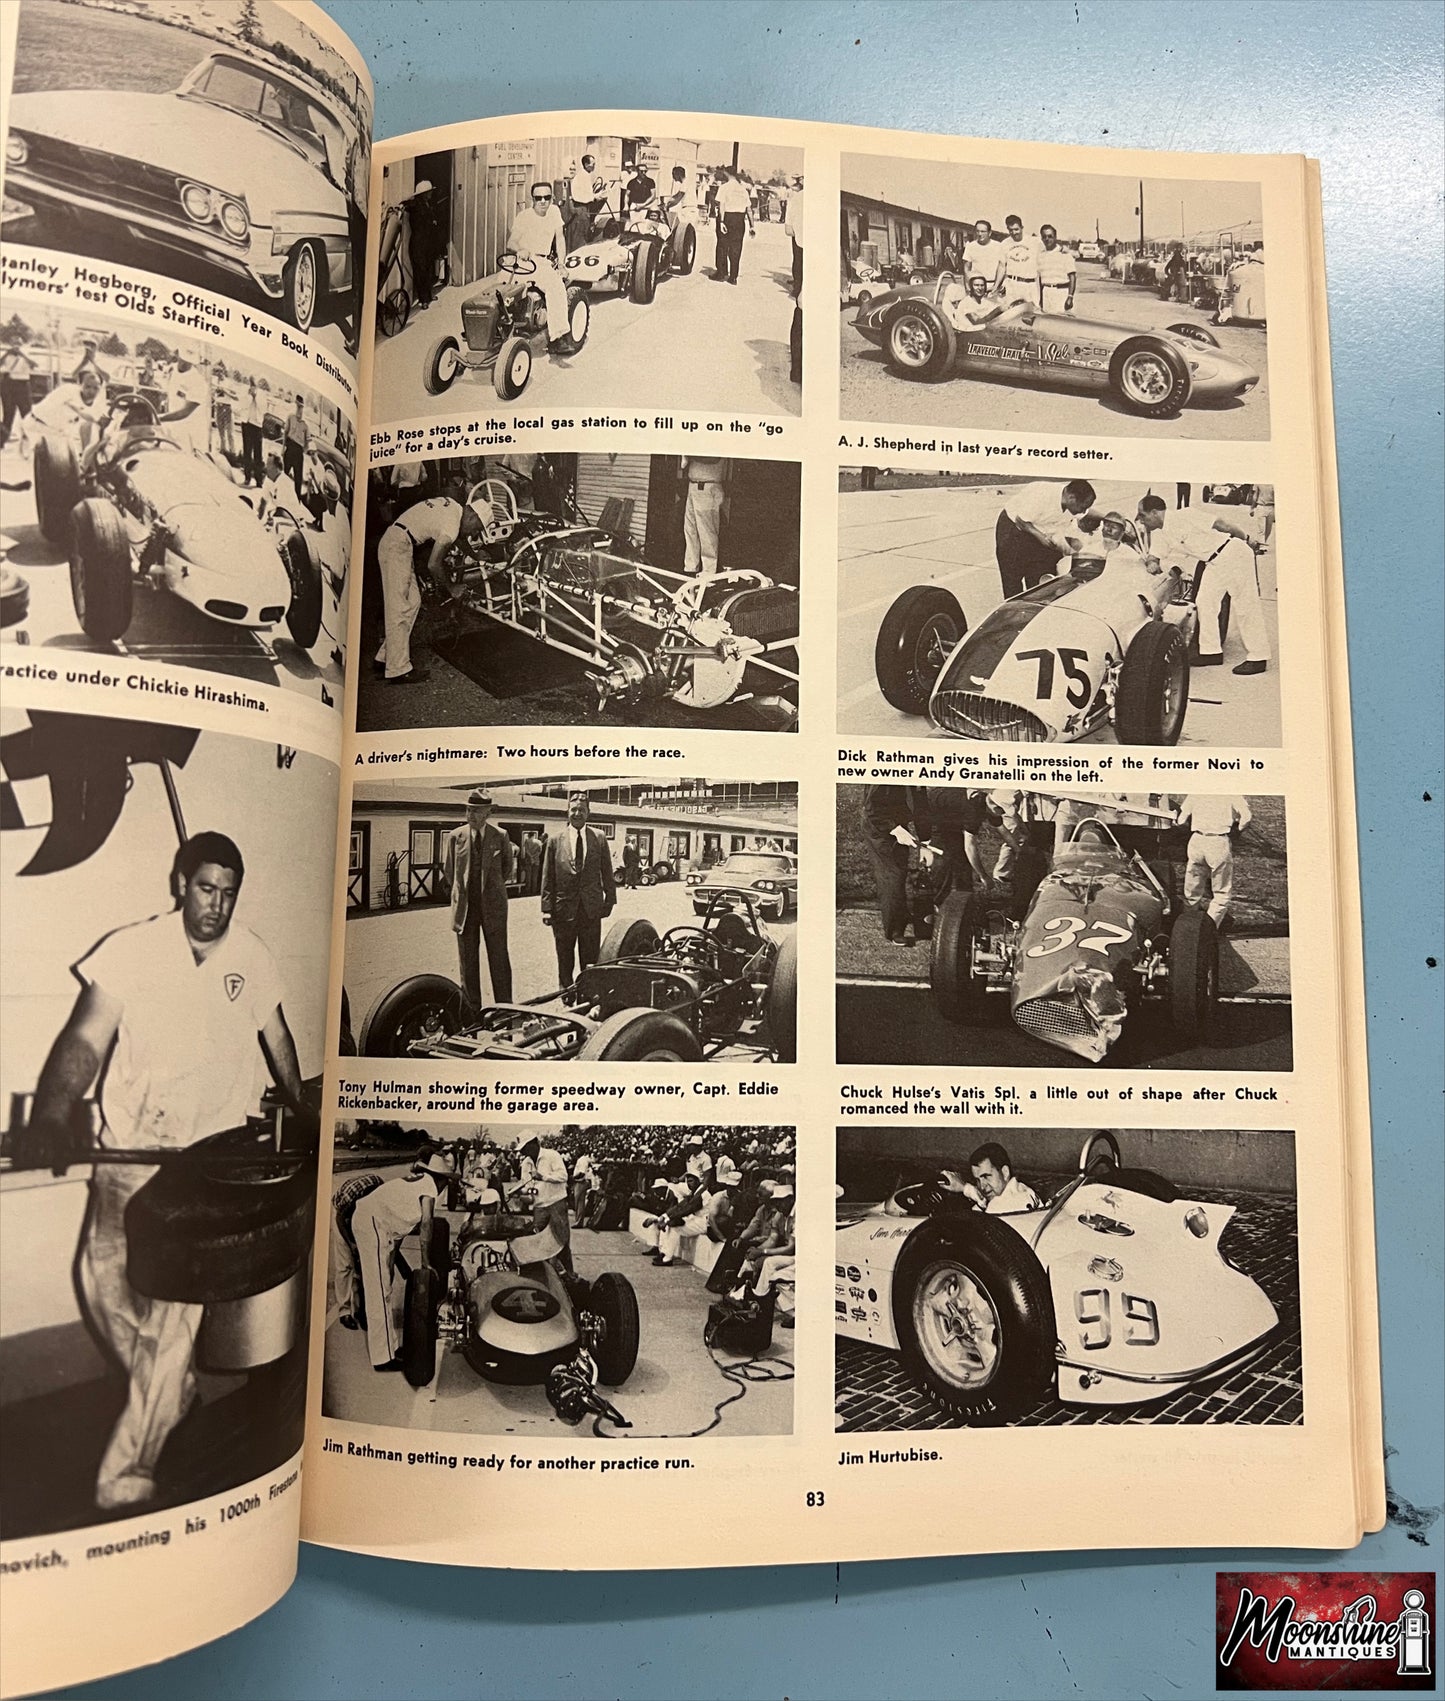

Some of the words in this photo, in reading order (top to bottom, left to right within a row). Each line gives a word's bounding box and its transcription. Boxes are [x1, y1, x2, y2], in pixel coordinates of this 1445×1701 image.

[565, 255, 600, 269] 86
[75, 285, 108, 304] test
[114, 291, 156, 316] Olds
[162, 305, 225, 337] Starfire.
[74, 266, 157, 302] Hegberg,
[171, 291, 231, 322] Official
[241, 313, 273, 339] Year
[281, 332, 309, 359] Book
[315, 352, 353, 395] Distributor
[369, 431, 392, 446] Ebb
[396, 429, 425, 442] Rose
[429, 424, 462, 437] stops
[467, 421, 480, 433] at
[485, 417, 507, 431] the
[513, 415, 544, 430] local
[550, 419, 575, 431] gas
[581, 415, 627, 428] station
[633, 417, 648, 429] to
[653, 416, 674, 430] fill
[681, 421, 699, 433] up
[706, 422, 723, 432] on
[729, 419, 752, 433] the
[404, 440, 424, 454] for
[426, 441, 434, 451] a
[437, 434, 471, 451] day's
[473, 432, 517, 446] cruise.
[837, 435, 853, 448] A.
[857, 436, 869, 448] J.
[873, 436, 936, 452] Shepherd
[940, 439, 953, 453] in
[957, 440, 981, 454] last
[984, 444, 1023, 457] year's
[1027, 446, 1069, 459] record
[1072, 449, 1113, 461] setter.
[65, 669, 121, 688] under
[126, 674, 190, 697] Chickie
[194, 684, 270, 713] Hirashima.
[1015, 648, 1092, 710] 75
[354, 753, 365, 766] A
[367, 749, 413, 765] driver's
[416, 746, 488, 763] nightmare:
[496, 745, 527, 758] Two
[530, 744, 570, 758] hours
[574, 744, 621, 758] before
[625, 745, 648, 758] the
[652, 749, 686, 759] race.
[837, 749, 867, 763] Dick
[876, 750, 935, 765] Rathman
[943, 752, 980, 767] gives
[988, 752, 1008, 767] his
[1016, 754, 1090, 769] impression
[1098, 756, 1113, 769] of
[1121, 756, 1144, 770] the
[1152, 756, 1200, 770] former
[1207, 758, 1241, 771] Novi
[1249, 759, 1265, 770] to
[837, 767, 867, 777] new
[870, 768, 915, 778] owner
[918, 765, 955, 782] Andy
[959, 767, 1025, 781] Granatelli
[1029, 772, 1047, 782] on
[1050, 769, 1073, 783] the
[1076, 769, 1104, 783] left.
[1026, 916, 1133, 958] 37
[338, 1079, 368, 1097] Tony
[372, 1079, 422, 1095] Hulman
[427, 1080, 488, 1099] showing
[494, 1080, 545, 1096] former
[551, 1081, 626, 1099] speedway
[633, 1085, 685, 1099] owner,
[692, 1081, 730, 1099] Capt.
[738, 1081, 779, 1096] Eddie
[840, 1084, 883, 1099] Chuck
[892, 1084, 942, 1100] Hulse's
[950, 1085, 986, 1100] Vatis
[994, 1085, 1021, 1102] Spl.
[1029, 1090, 1037, 1100] a
[1046, 1085, 1078, 1100] little
[1086, 1088, 1110, 1100] out
[1118, 1086, 1134, 1100] of
[1141, 1086, 1183, 1103] shape
[1192, 1086, 1226, 1101] after
[1234, 1086, 1278, 1101] Chuck
[337, 1094, 423, 1113] Rickenbacker,
[426, 1096, 476, 1111] around
[479, 1096, 504, 1111] the
[506, 1101, 558, 1114] garage
[562, 1101, 599, 1112] area.
[840, 1100, 909, 1115] romanced
[913, 1100, 936, 1115] the
[939, 1100, 970, 1115] wall
[974, 1101, 1005, 1115] with
[1009, 1101, 1023, 1115] it.
[500, 1289, 547, 1317] 4
[1073, 1288, 1161, 1351] 99
[322, 1437, 344, 1455] Jim
[347, 1441, 403, 1463] Rathman
[406, 1450, 458, 1470] getting
[462, 1453, 506, 1472] ready
[509, 1454, 533, 1470] for
[537, 1455, 597, 1471] another
[600, 1455, 660, 1473] practice
[664, 1458, 695, 1470] run.
[837, 1451, 864, 1466] Jim
[868, 1447, 943, 1464] Hurtubise.
[806, 1490, 825, 1508] 83
[86, 1530, 171, 1559] mounting
[184, 1516, 207, 1535] his
[219, 1493, 261, 1523] 1000th
